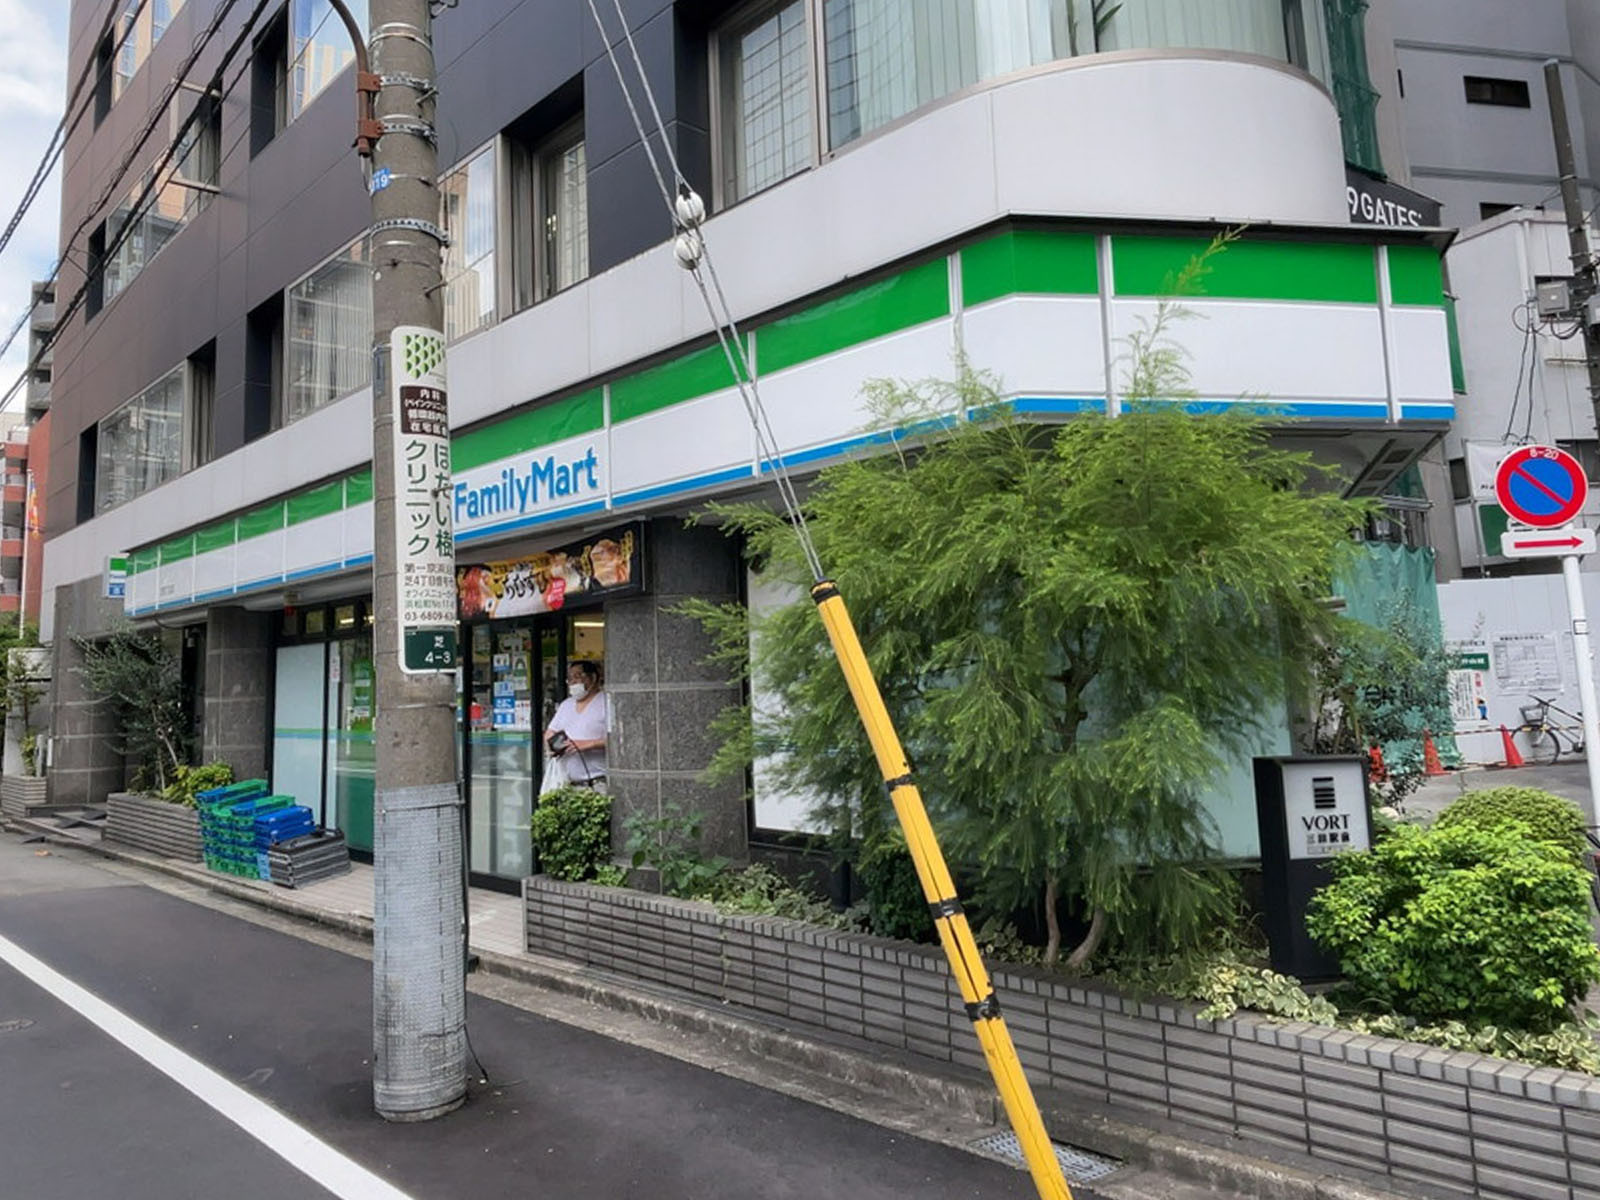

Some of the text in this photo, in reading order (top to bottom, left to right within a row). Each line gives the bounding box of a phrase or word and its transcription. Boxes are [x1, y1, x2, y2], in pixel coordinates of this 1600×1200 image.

[405, 439, 430, 557] クリニック
[454, 446, 598, 523] FamilyMart
[424, 651, 452, 664] 4-3
[1302, 813, 1351, 831] VORT
